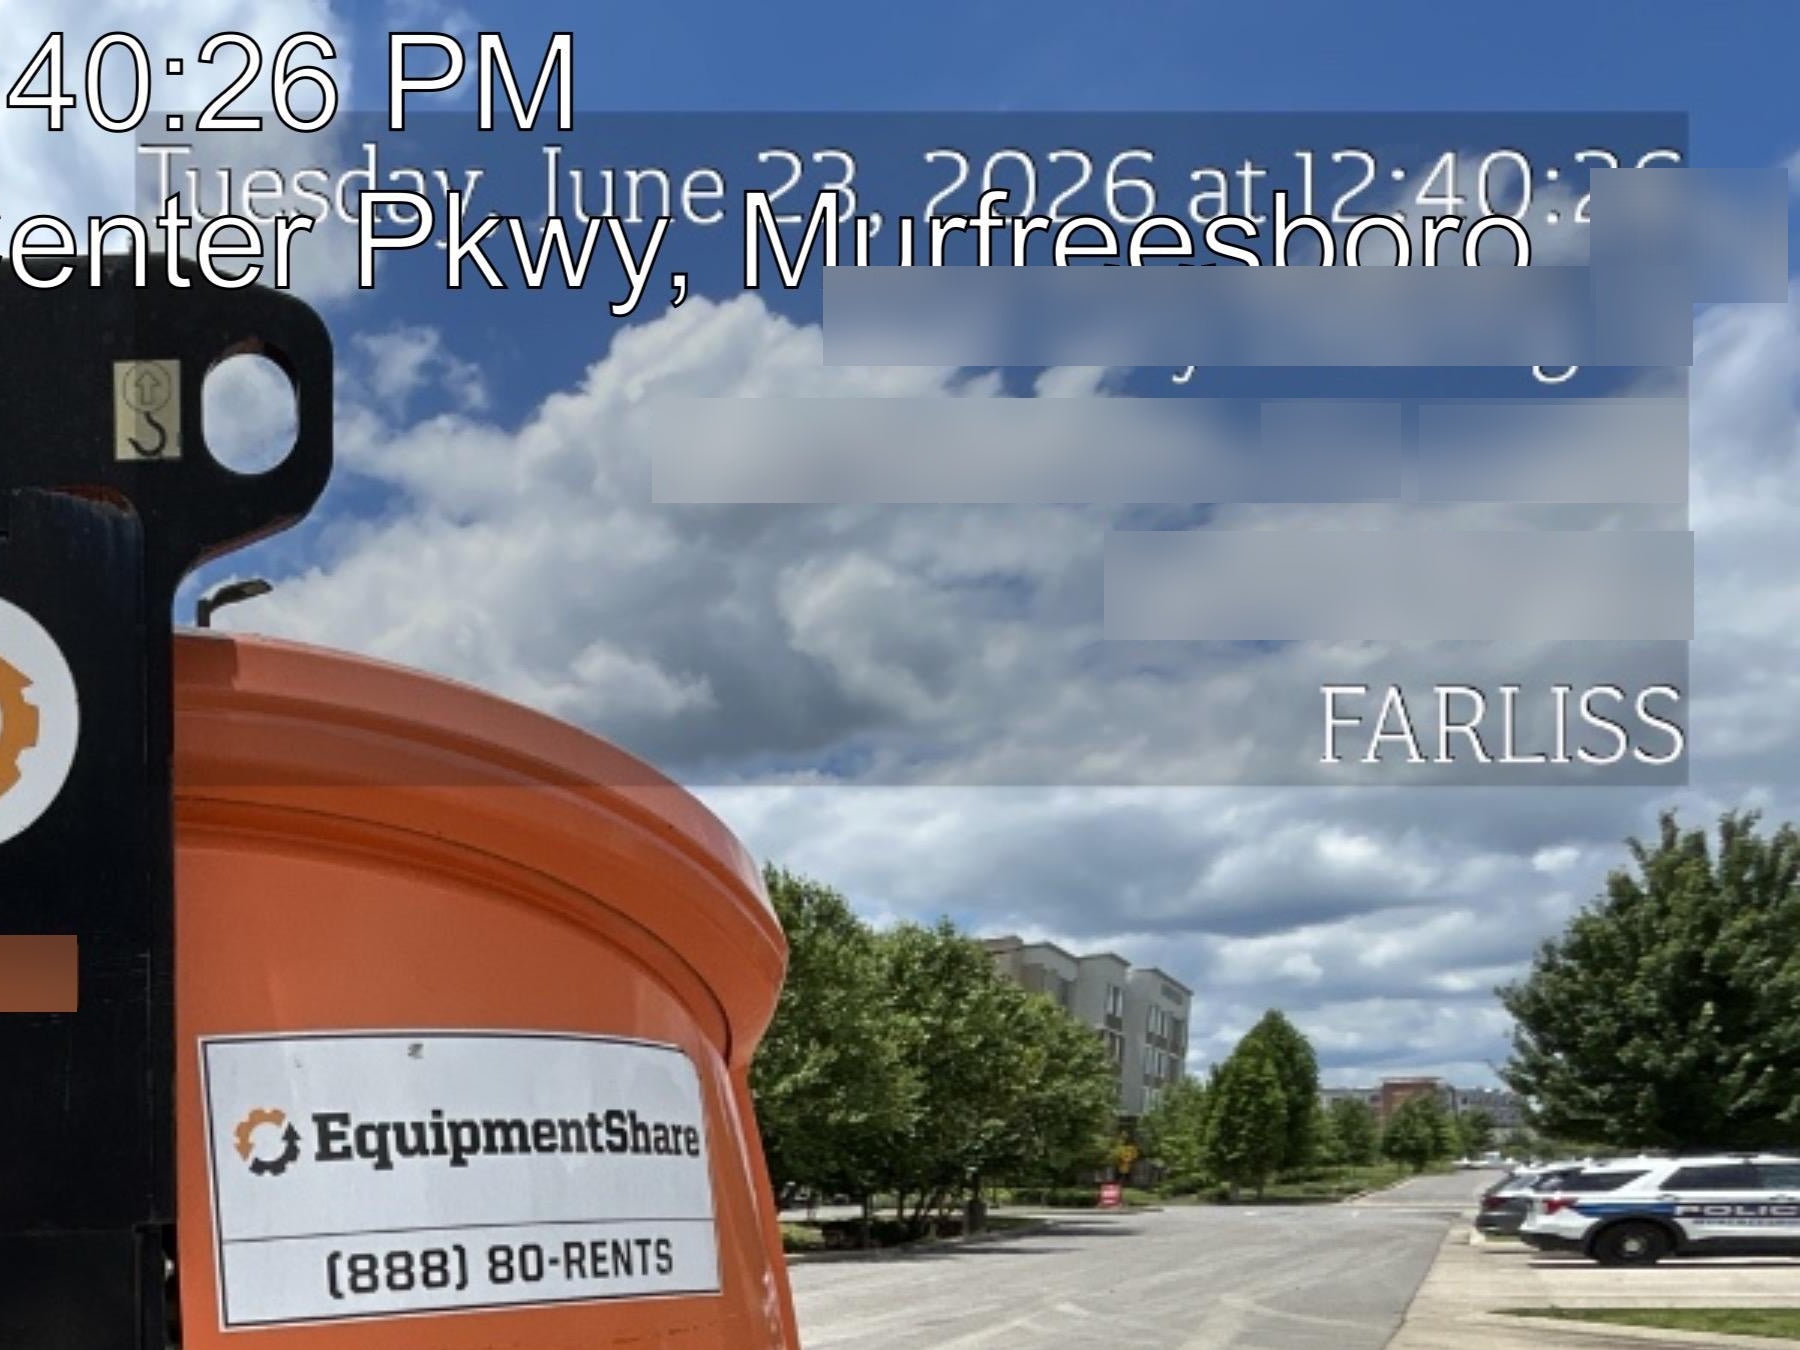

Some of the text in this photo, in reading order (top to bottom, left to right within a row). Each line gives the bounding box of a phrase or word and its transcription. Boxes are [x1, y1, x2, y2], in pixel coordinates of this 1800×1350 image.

[311, 1108, 700, 1168] EquipmentShare
[326, 1238, 674, 1300] (888) 80-RENTS
